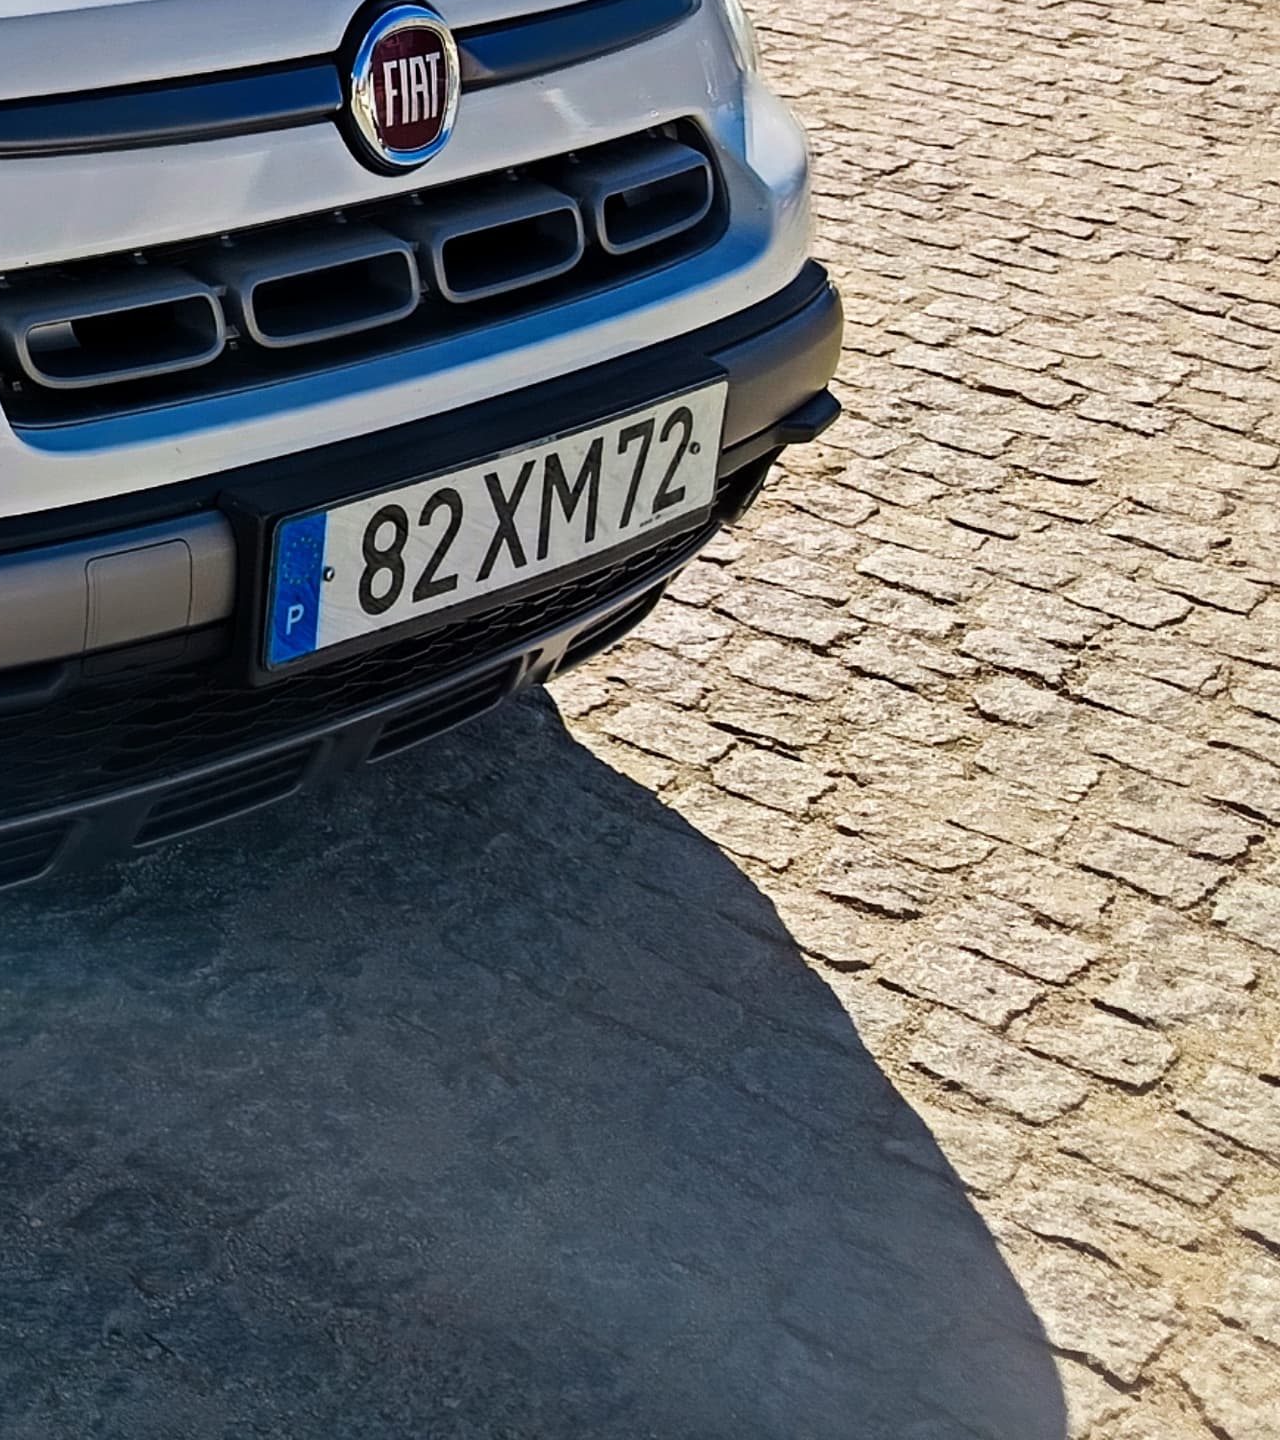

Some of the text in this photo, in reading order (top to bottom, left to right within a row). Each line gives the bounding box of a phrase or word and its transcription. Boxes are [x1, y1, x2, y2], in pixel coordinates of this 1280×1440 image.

[382, 51, 441, 128] FIAT
[358, 406, 694, 616] 82XM72
[286, 603, 305, 636] P
